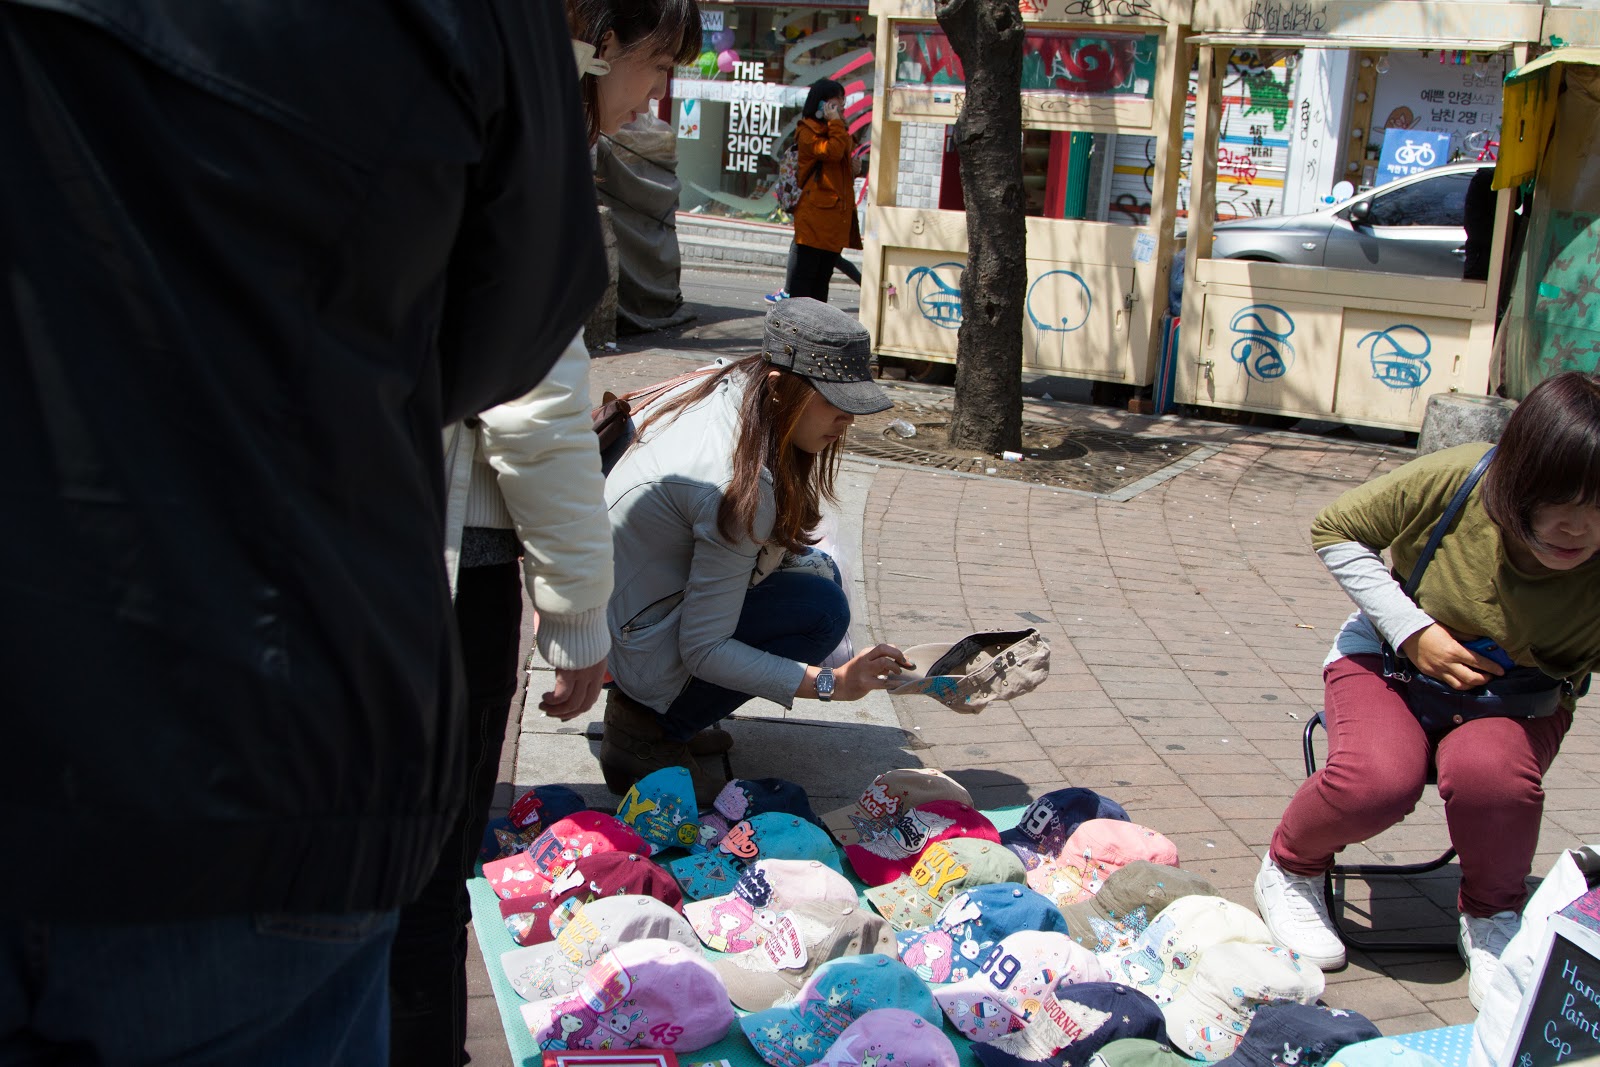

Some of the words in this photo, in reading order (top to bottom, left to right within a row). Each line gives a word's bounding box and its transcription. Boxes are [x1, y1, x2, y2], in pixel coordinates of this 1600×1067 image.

[732, 61, 764, 80] THE
[731, 81, 776, 100] SHOE
[1421, 89, 1445, 103] 예쁜
[729, 100, 783, 119] EVENT
[1431, 108, 1455, 123] 남친
[1457, 111, 1478, 125] 2명
[1249, 125, 1268, 135] ART
[980, 945, 1021, 990] 89
[1561, 992, 1600, 1043] Paint
[1544, 1020, 1572, 1062] Cap
